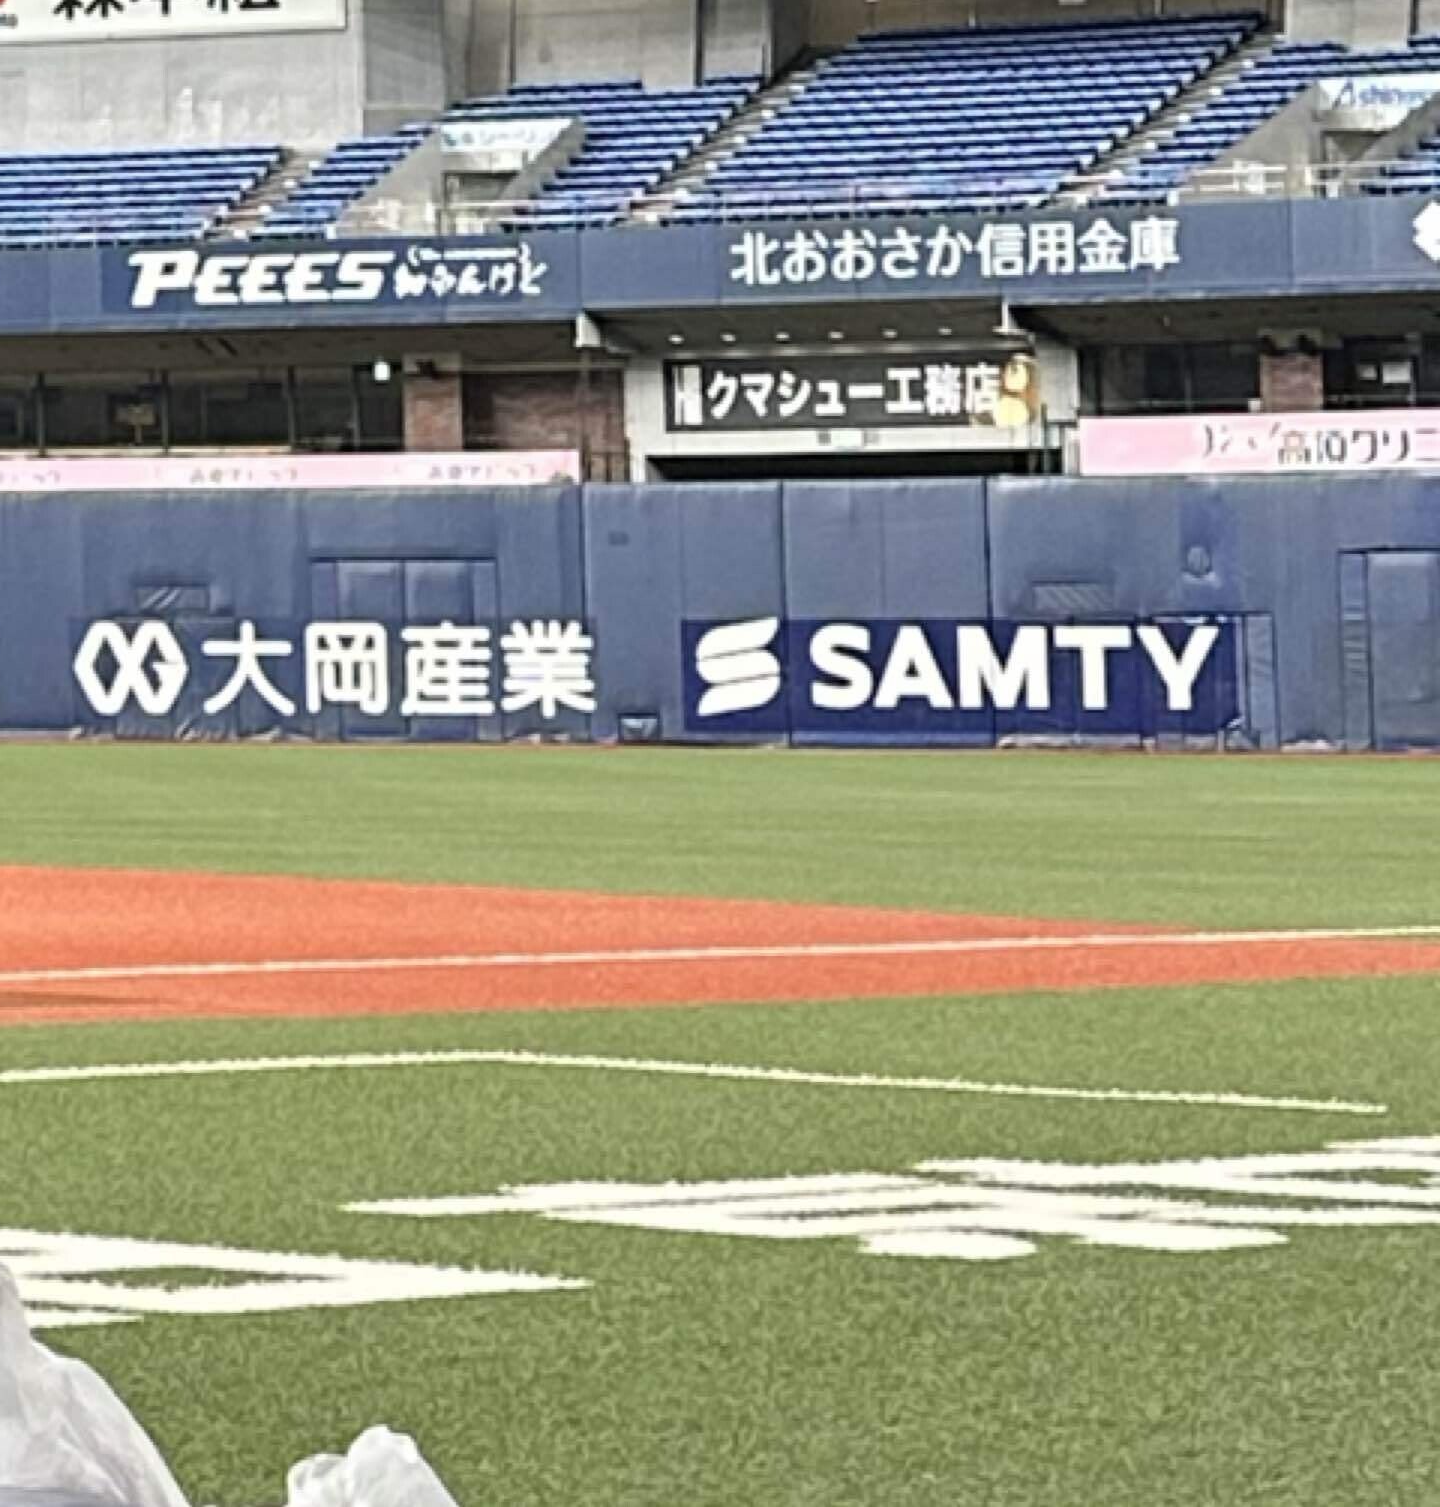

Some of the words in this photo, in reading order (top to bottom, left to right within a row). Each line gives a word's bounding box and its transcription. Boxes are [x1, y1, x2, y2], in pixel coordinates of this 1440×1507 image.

[729, 216, 1180, 285] 北おおさか信用金庫
[706, 362, 1001, 420] クマシュー工務店
[203, 620, 596, 718] 大岡産業
[810, 623, 1219, 711] SAMTY
